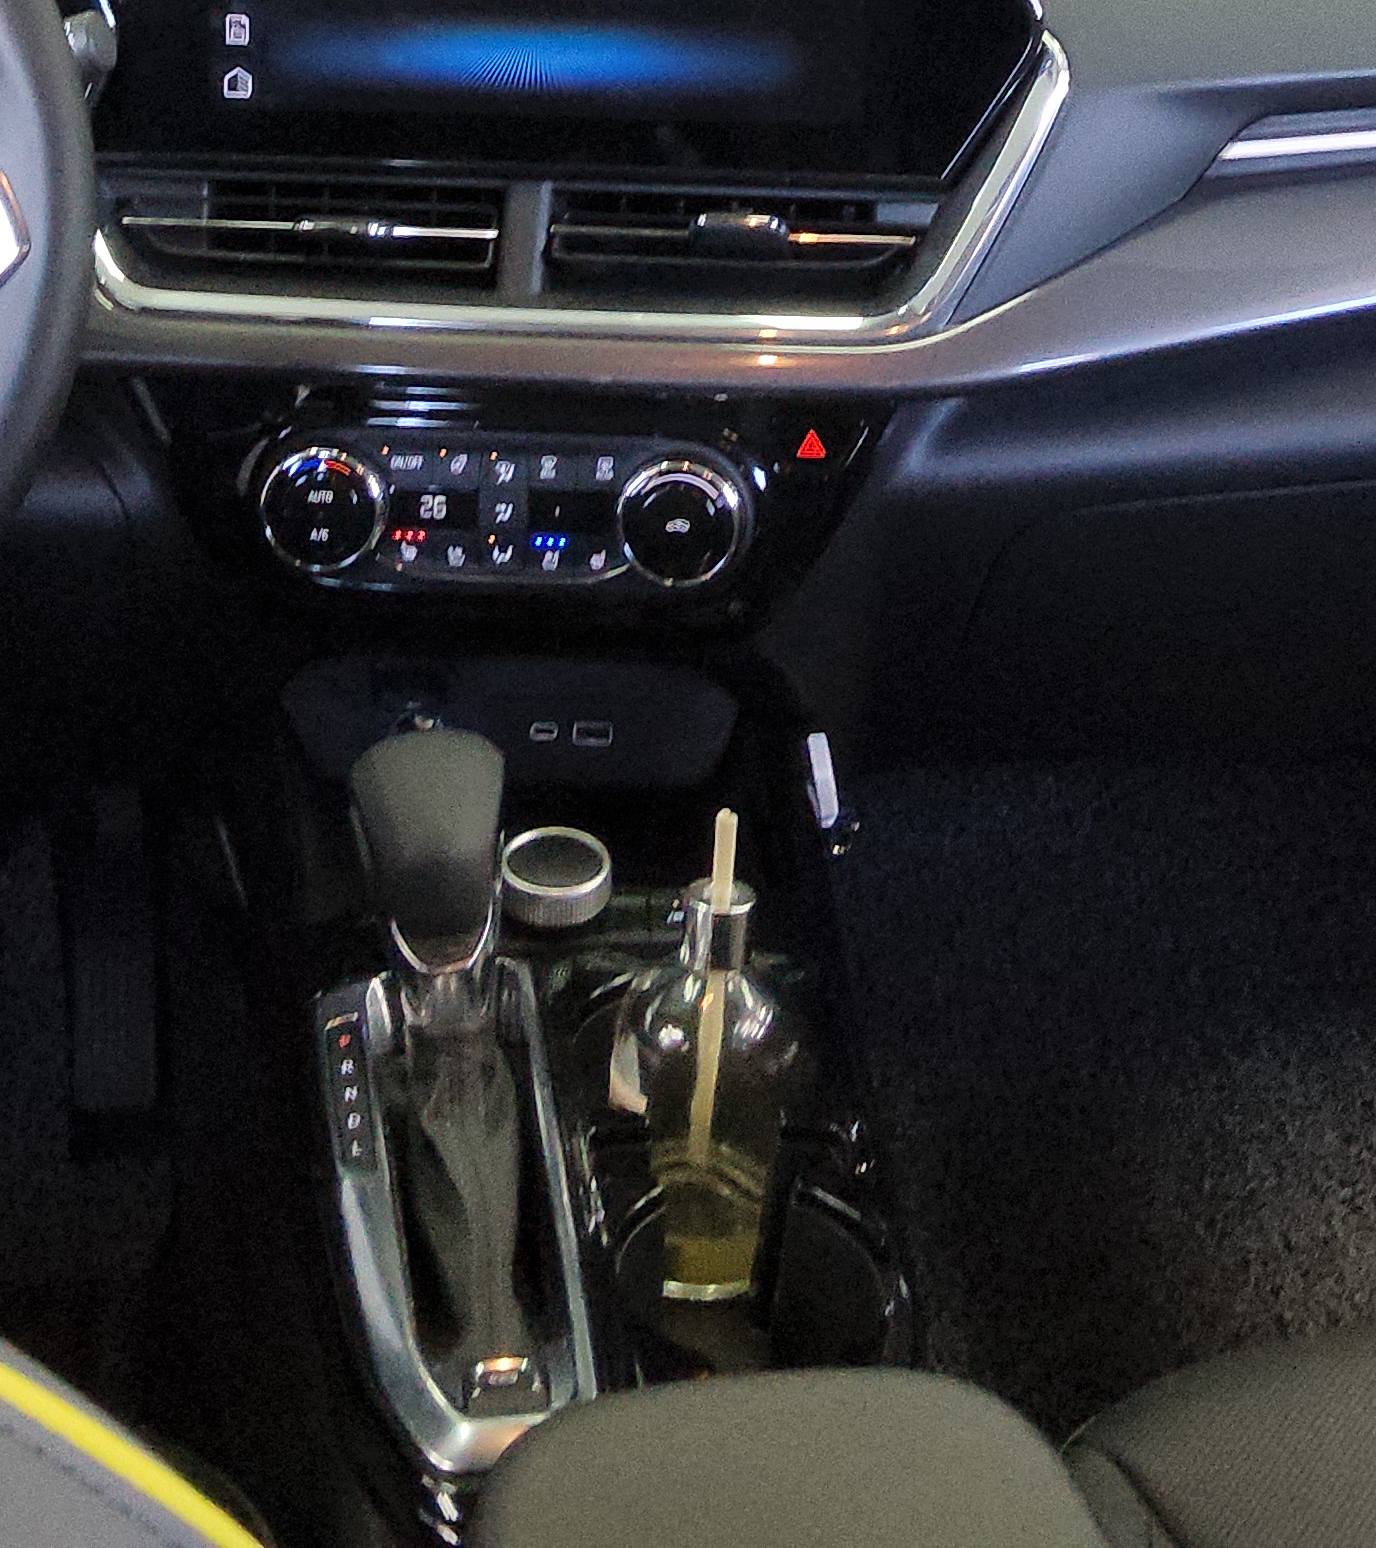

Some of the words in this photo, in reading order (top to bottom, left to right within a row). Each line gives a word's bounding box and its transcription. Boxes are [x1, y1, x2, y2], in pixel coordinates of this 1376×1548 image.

[307, 489, 334, 504] AUTO
[341, 1058, 355, 1075] R
[344, 1085, 359, 1103] N
